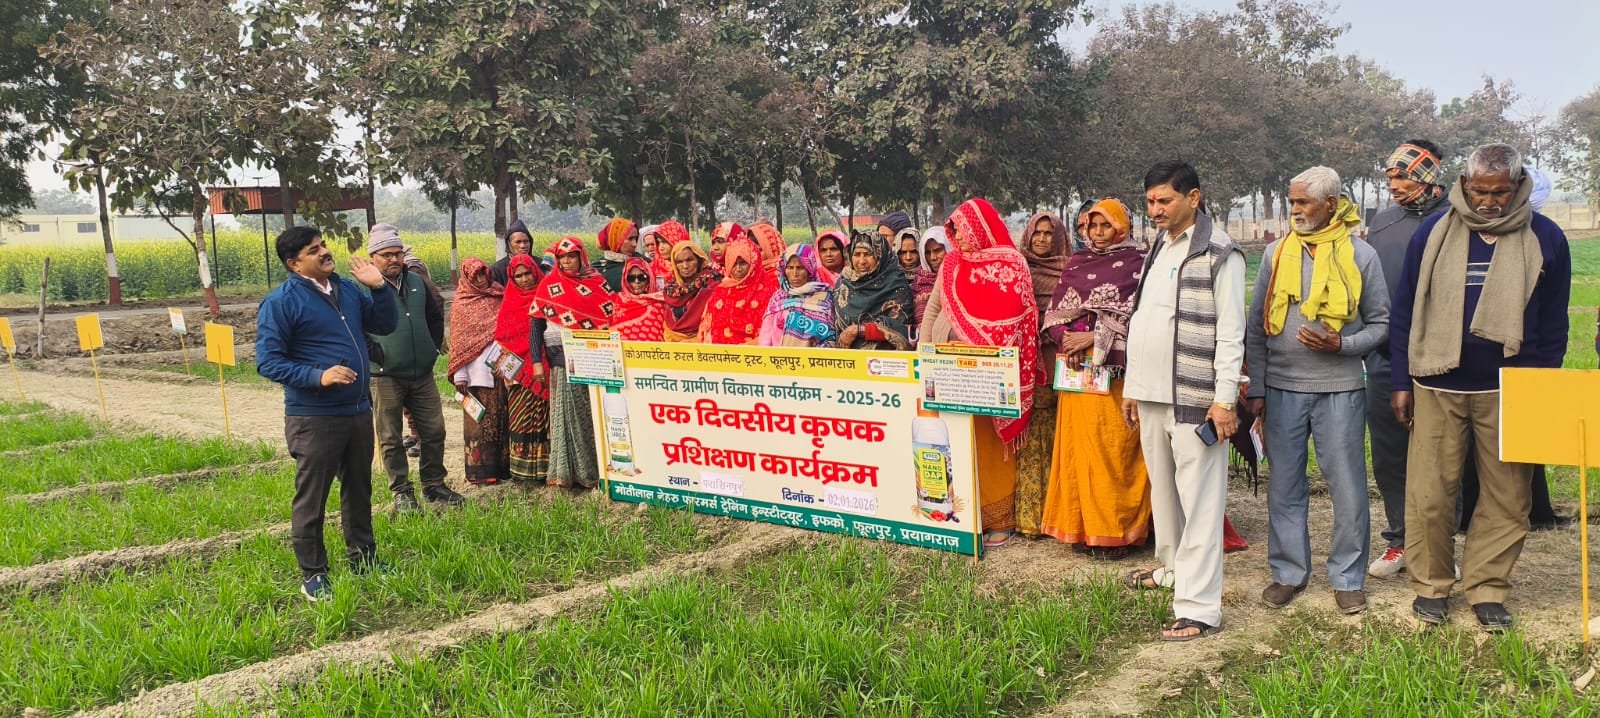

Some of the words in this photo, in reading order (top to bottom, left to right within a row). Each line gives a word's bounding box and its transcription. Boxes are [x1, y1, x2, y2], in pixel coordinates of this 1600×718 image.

[770, 356, 805, 372] फूलपुर,
[808, 357, 856, 370] प्रयागराज
[634, 374, 678, 391] समन्वित
[680, 376, 719, 394] ग्रामीण
[722, 378, 765, 397] विकास
[768, 382, 821, 402] कार्यक्रम
[837, 389, 901, 408] 2025-26
[649, 402, 692, 425] एक
[694, 398, 797, 435] दिवसीय
[799, 414, 888, 449] कृषक
[662, 437, 757, 472] प्रशिक्षण
[759, 450, 879, 487] कार्यक्रम
[668, 475, 690, 487] स्थान
[924, 470, 942, 480] DAP
[782, 487, 815, 504] दिनांक
[614, 483, 654, 500] मोतीलाल
[899, 528, 960, 548] प्रयागराज
